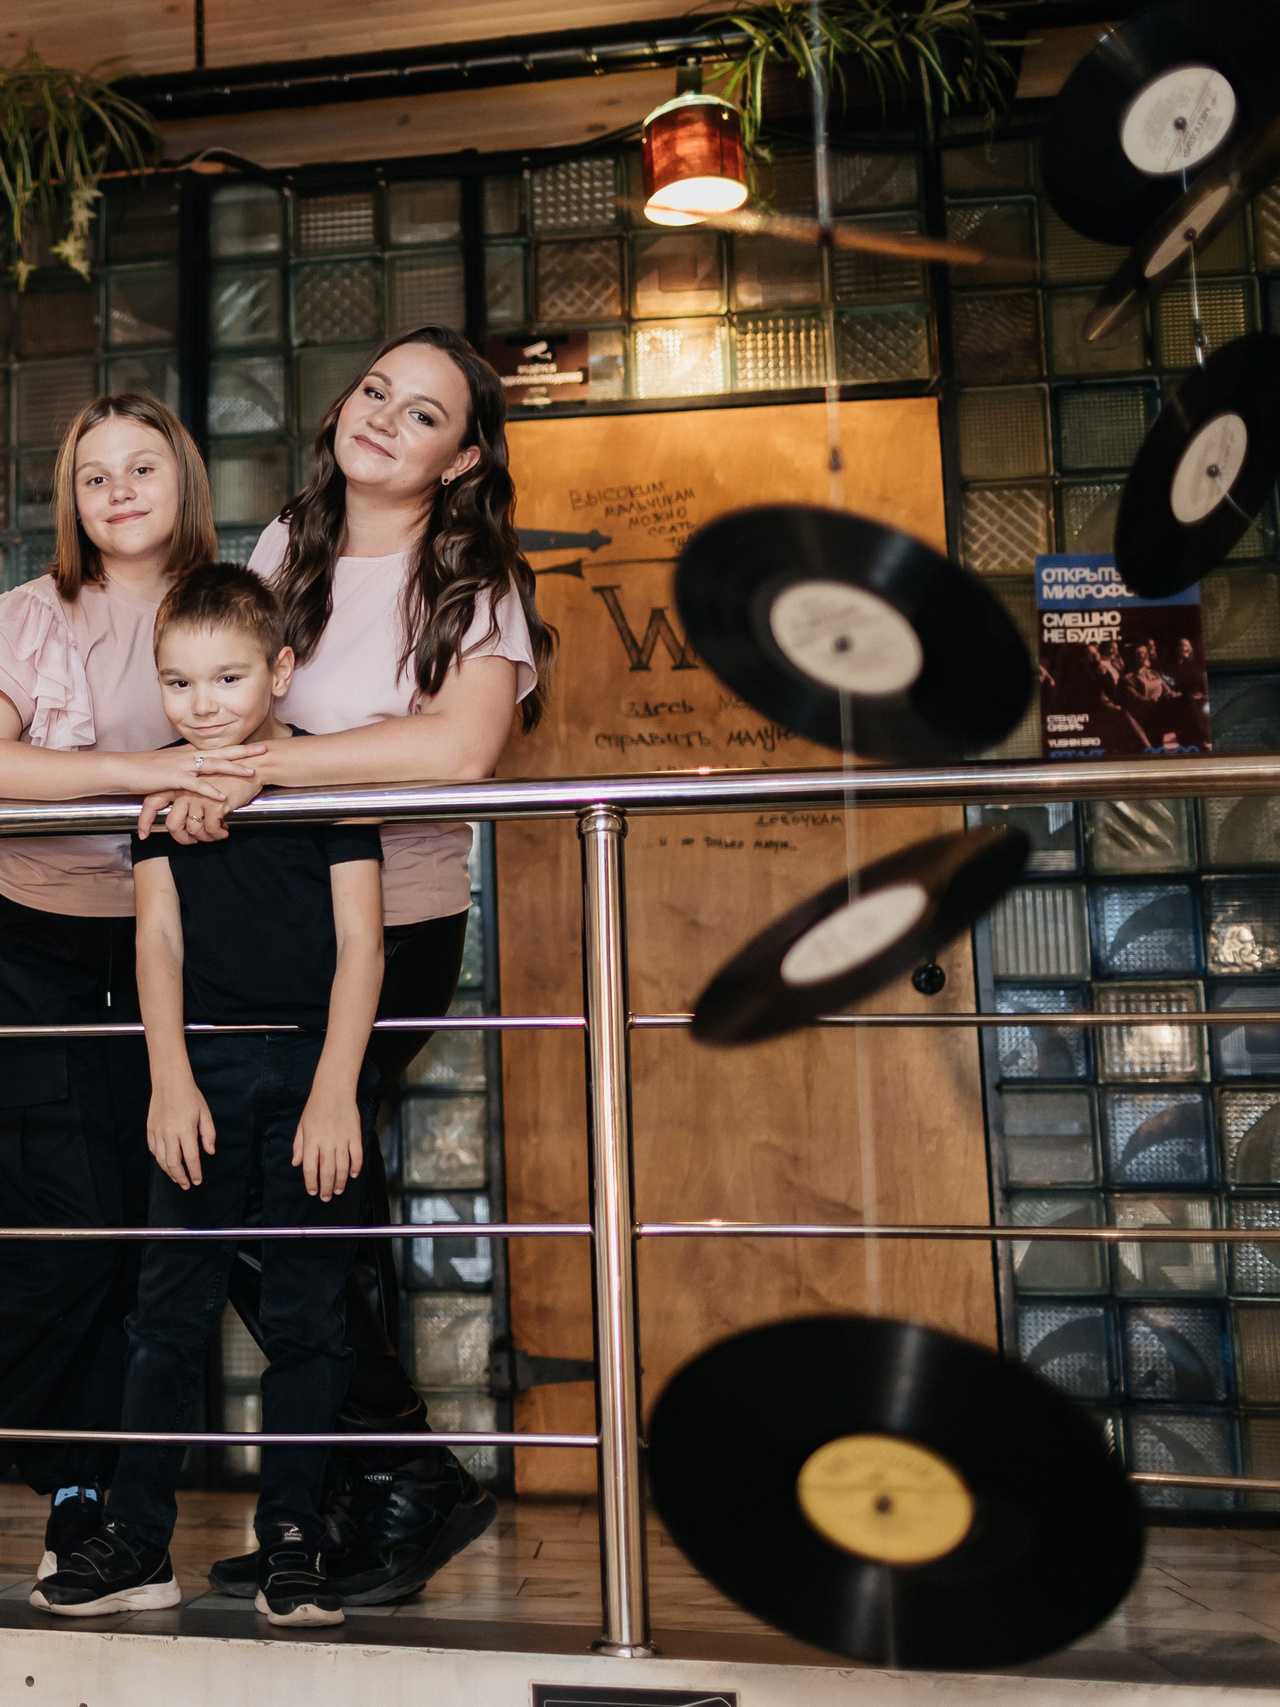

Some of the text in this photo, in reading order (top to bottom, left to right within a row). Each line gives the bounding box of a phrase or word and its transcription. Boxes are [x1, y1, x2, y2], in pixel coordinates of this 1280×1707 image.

[1041, 566, 1122, 583] ОТКРЫТ
[1042, 583, 1134, 600] МИКРОФ
[1042, 610, 1122, 628] СМЕШНО
[1043, 628, 1065, 643] НЕ
